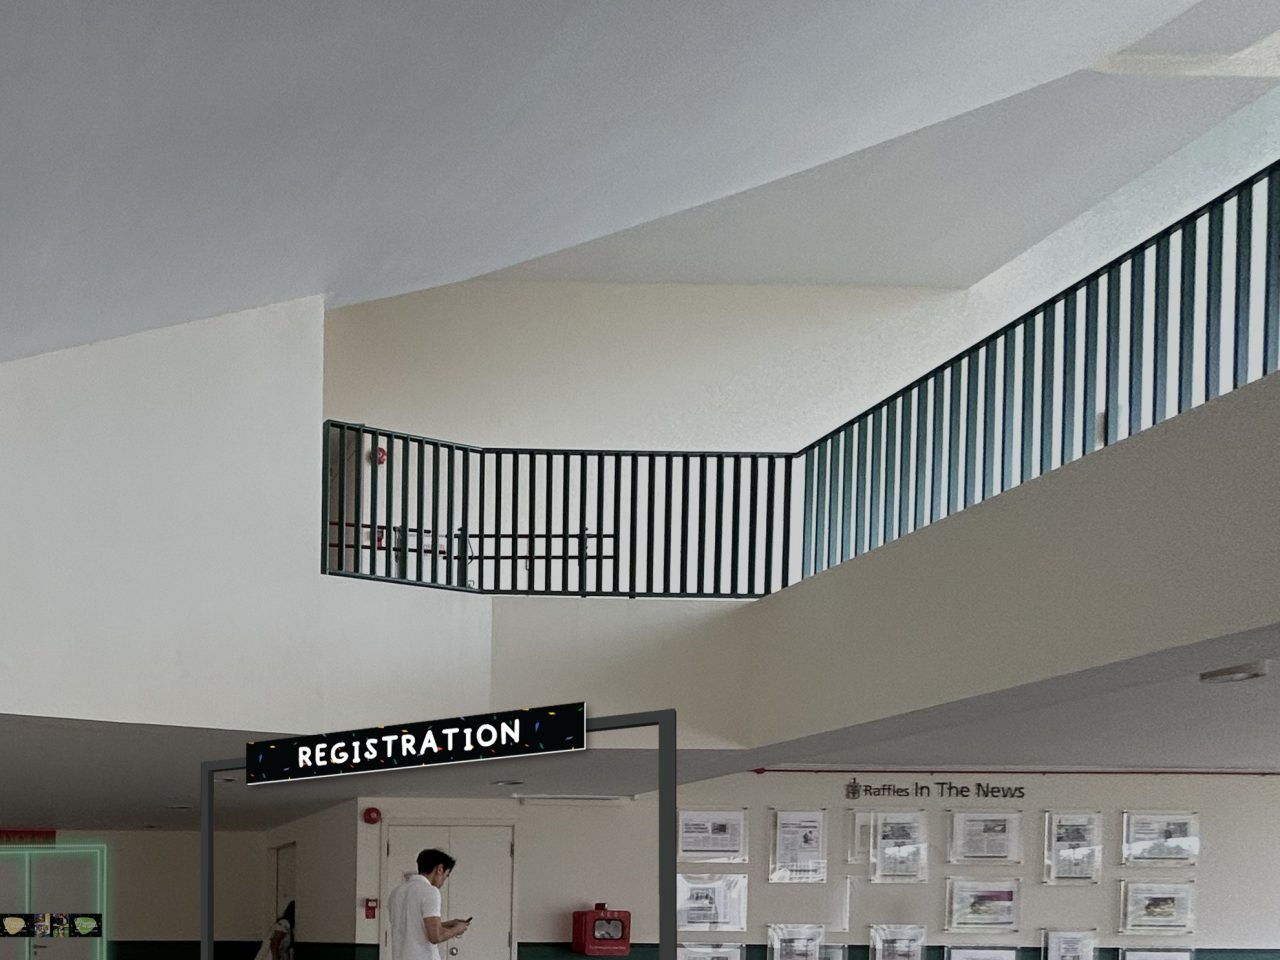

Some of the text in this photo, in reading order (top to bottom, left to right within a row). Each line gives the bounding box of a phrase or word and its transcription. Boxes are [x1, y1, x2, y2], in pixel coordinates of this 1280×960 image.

[298, 718, 520, 768] REGISTRATION
[863, 782, 1025, 798] Raffles In The News
